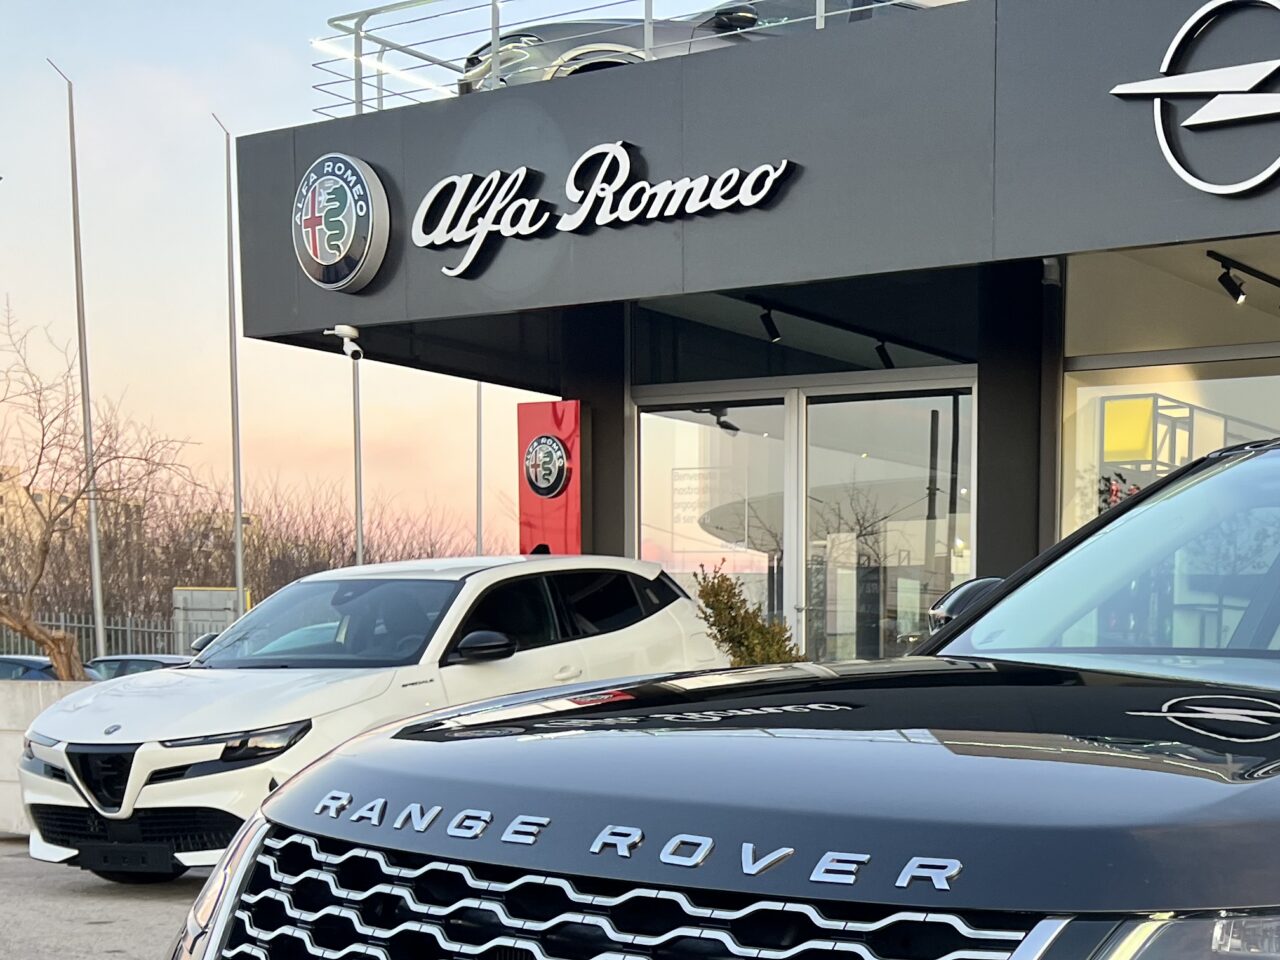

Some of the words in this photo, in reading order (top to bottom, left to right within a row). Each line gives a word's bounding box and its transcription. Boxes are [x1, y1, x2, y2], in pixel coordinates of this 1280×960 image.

[295, 172, 317, 226] ALFA
[323, 161, 367, 217] ROMEO
[411, 167, 549, 277] Alfa
[556, 141, 789, 232] Romeo
[313, 789, 551, 846] RANGE
[589, 824, 964, 891] ROVER
